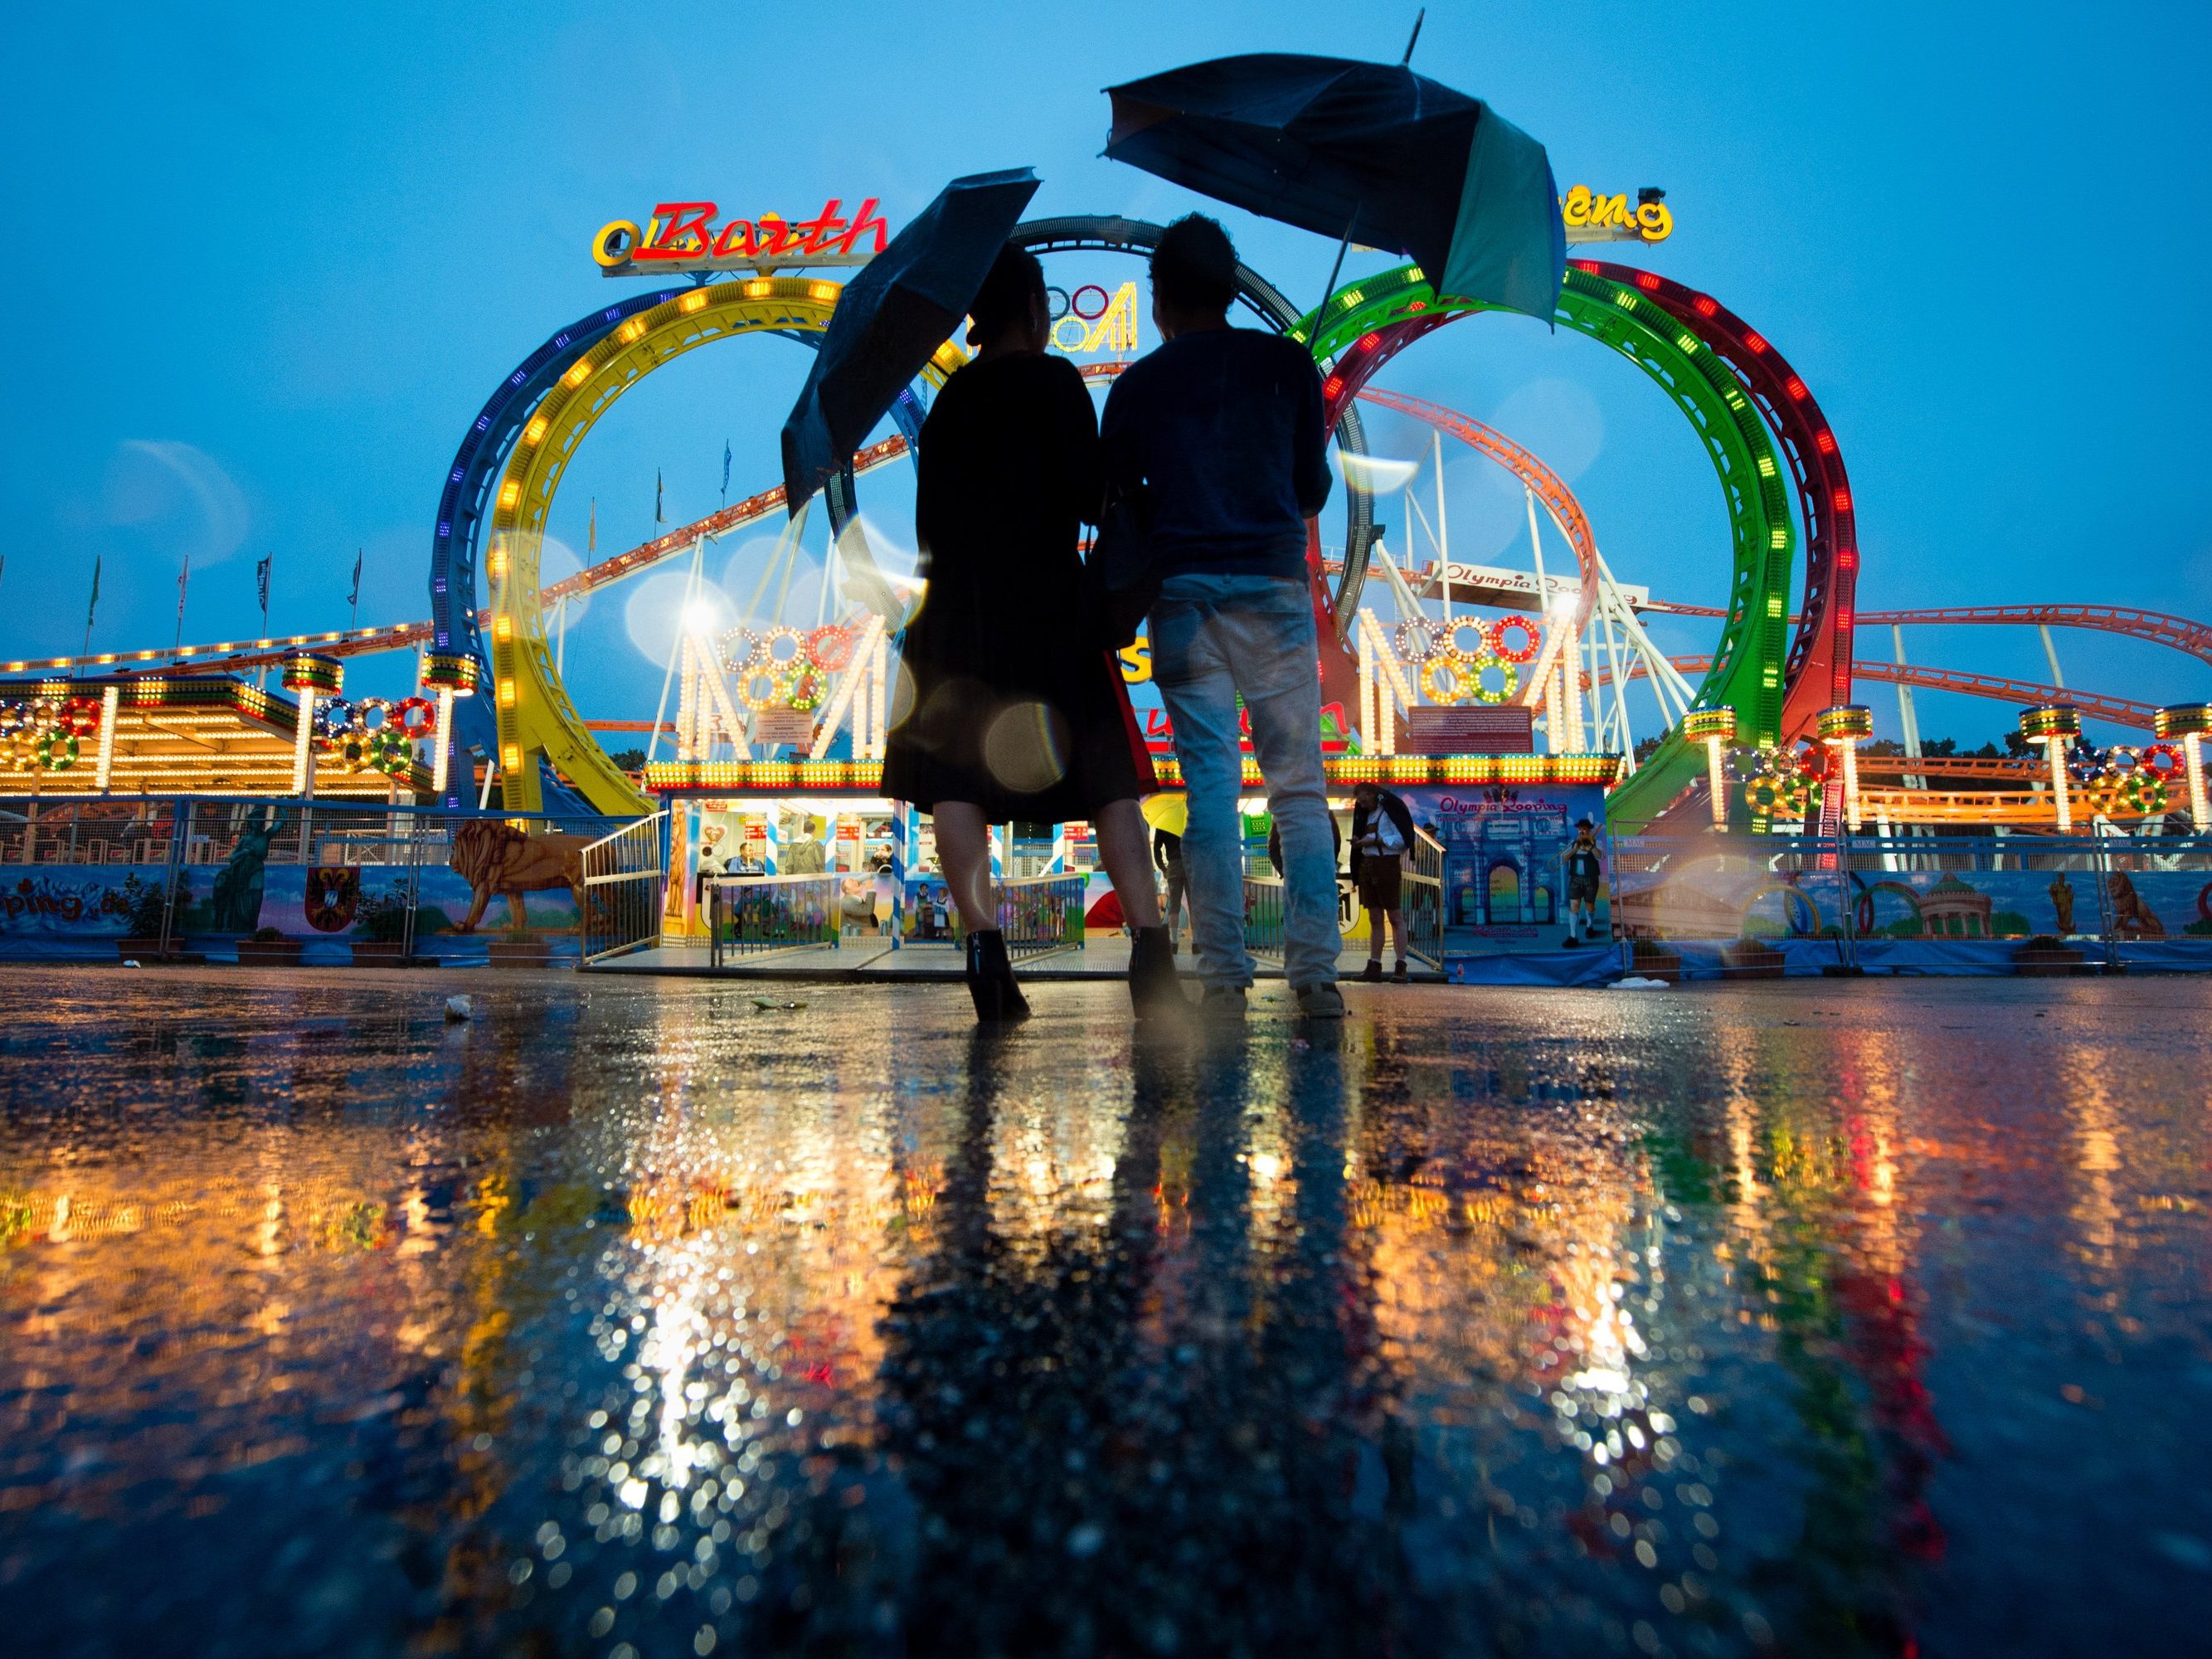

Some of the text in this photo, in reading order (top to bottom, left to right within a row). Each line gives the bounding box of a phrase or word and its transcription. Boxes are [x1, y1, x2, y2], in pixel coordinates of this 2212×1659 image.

[631, 197, 889, 260] Barth
[1447, 564, 1531, 589] Olympia
[1440, 796, 1568, 815] Olympia Looping
